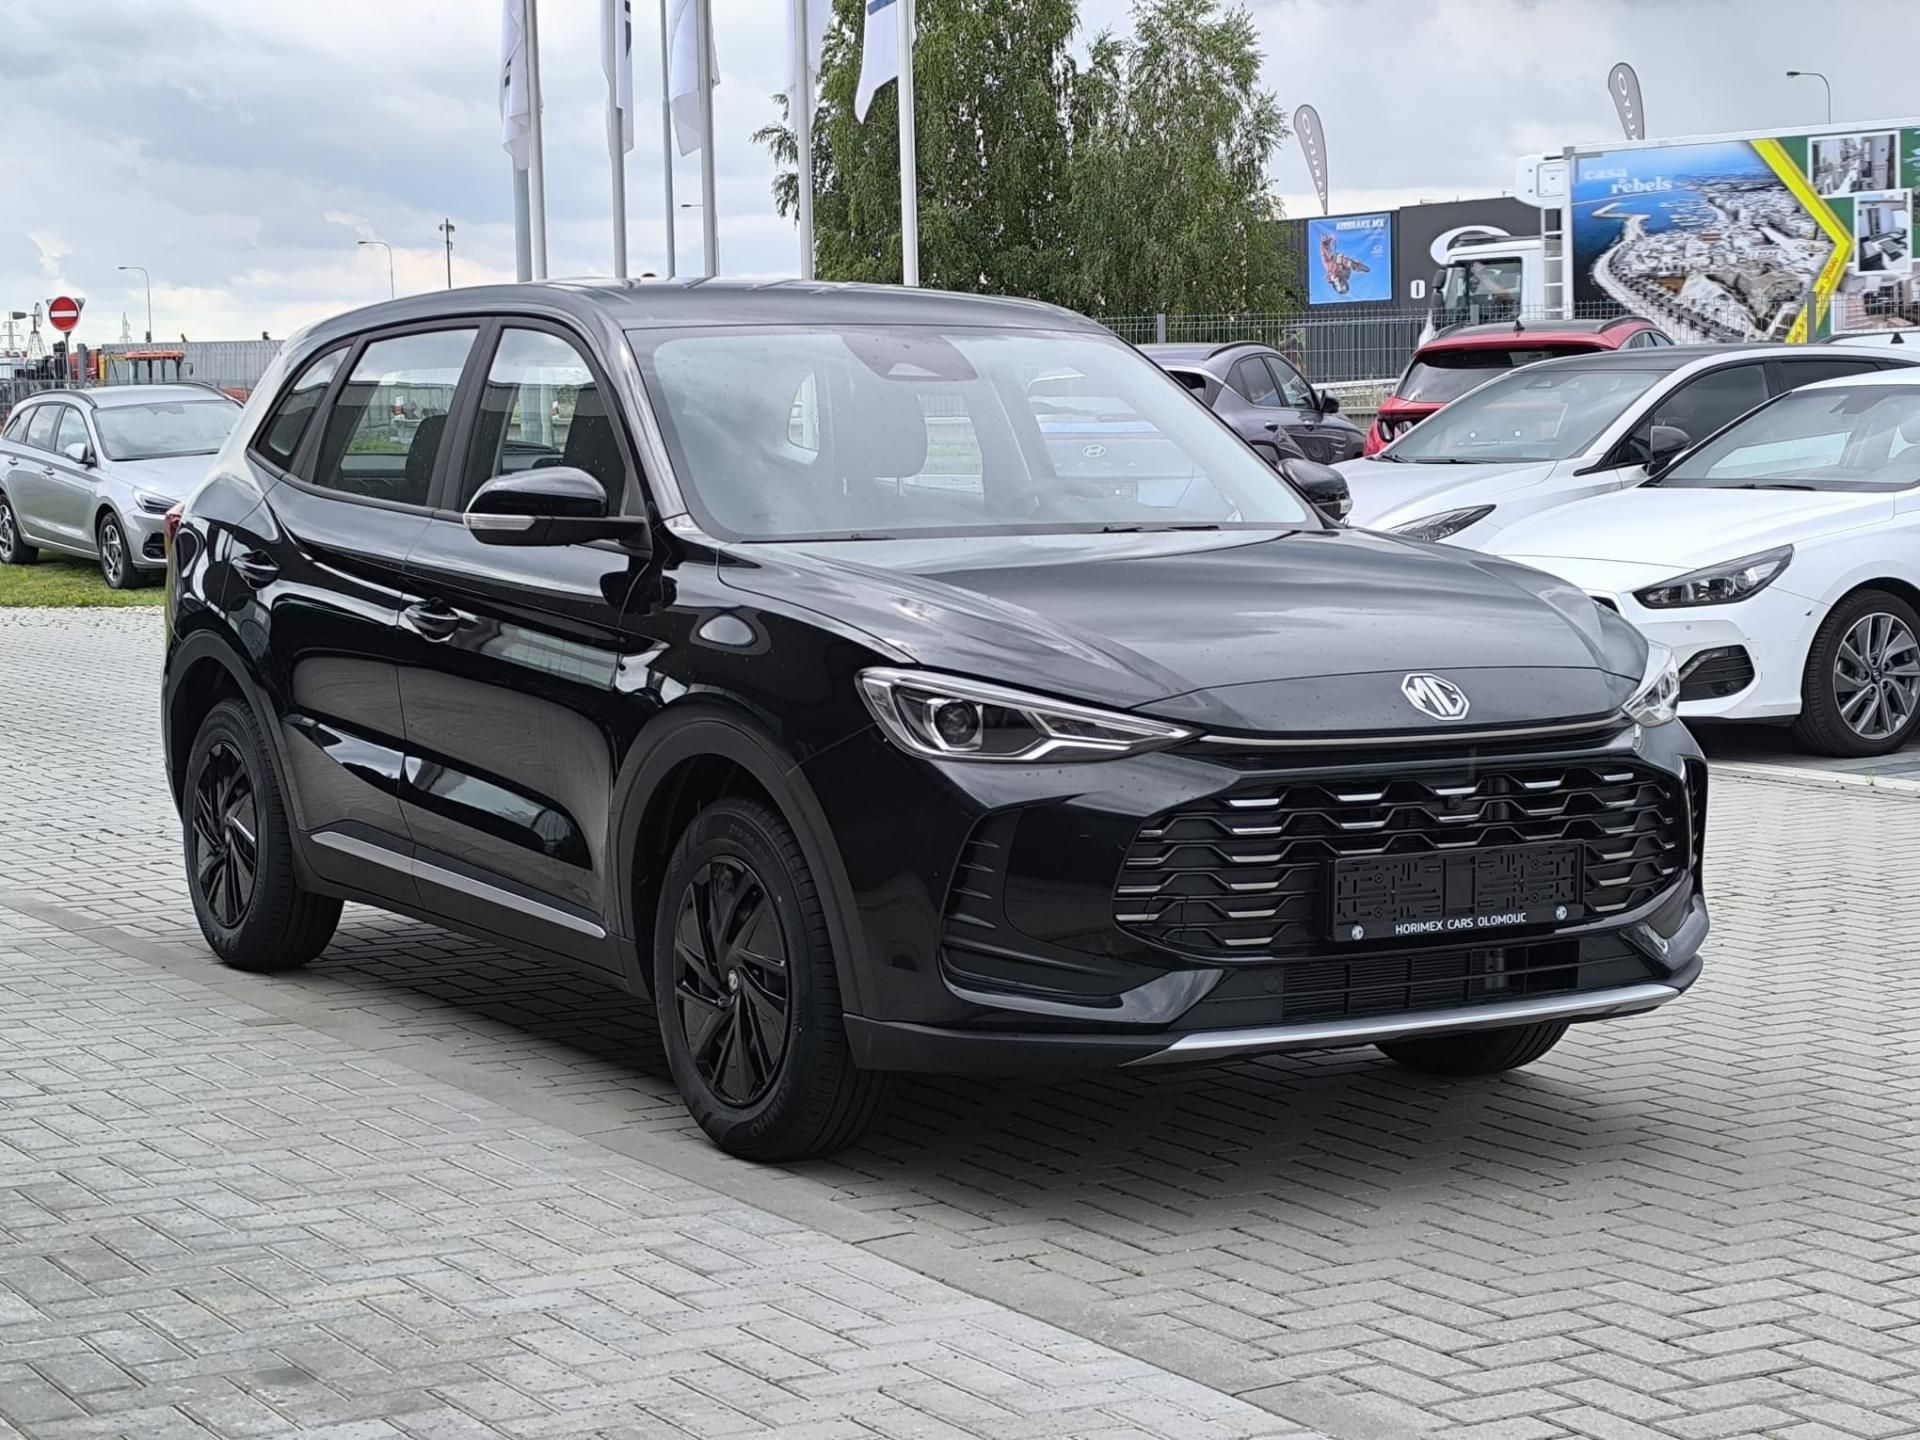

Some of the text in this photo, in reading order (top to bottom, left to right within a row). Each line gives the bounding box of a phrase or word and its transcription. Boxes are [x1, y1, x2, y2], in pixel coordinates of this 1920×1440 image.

[1584, 168, 1628, 180] casa
[1403, 675, 1467, 718] MG
[1395, 911, 1527, 936] HORIMEX CARS OLOMOUC
